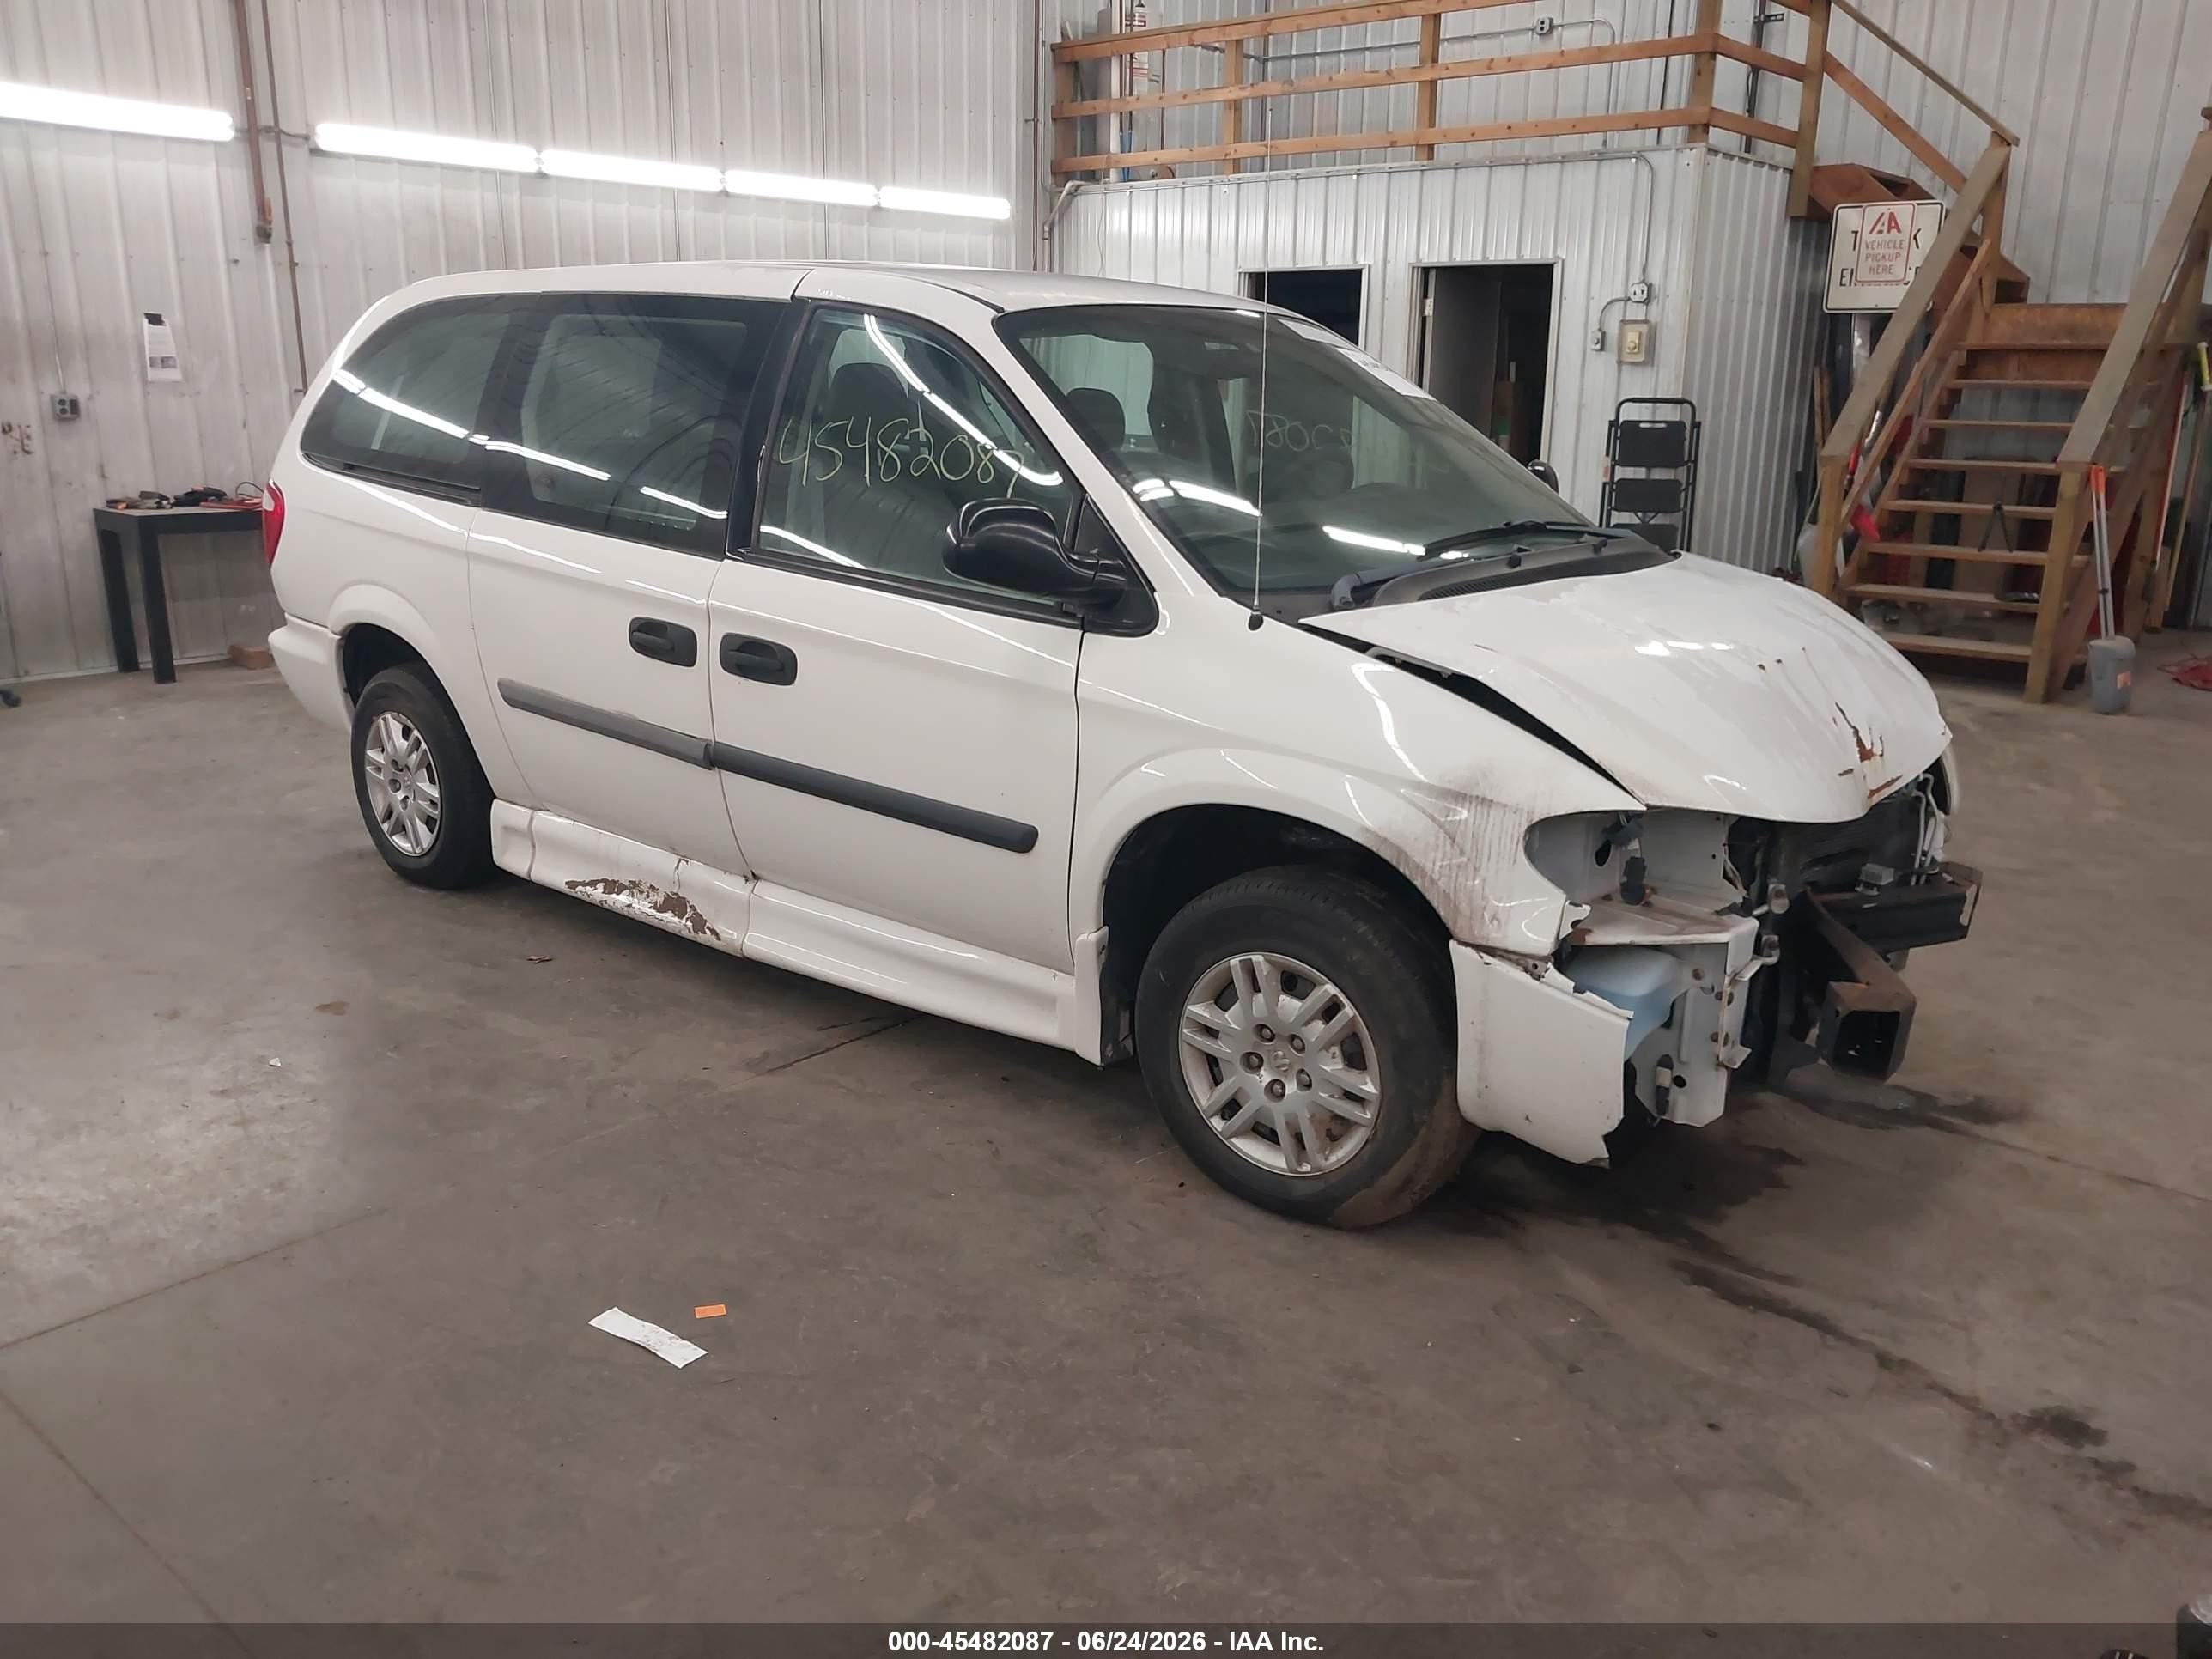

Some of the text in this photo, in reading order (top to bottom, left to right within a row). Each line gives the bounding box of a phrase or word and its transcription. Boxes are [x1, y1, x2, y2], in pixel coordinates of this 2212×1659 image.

[1864, 239, 1905, 251] VEHICLE
[1864, 252, 1902, 263] PICKUP
[1869, 264, 1895, 275] HERE
[779, 416, 1024, 498] 45482087
